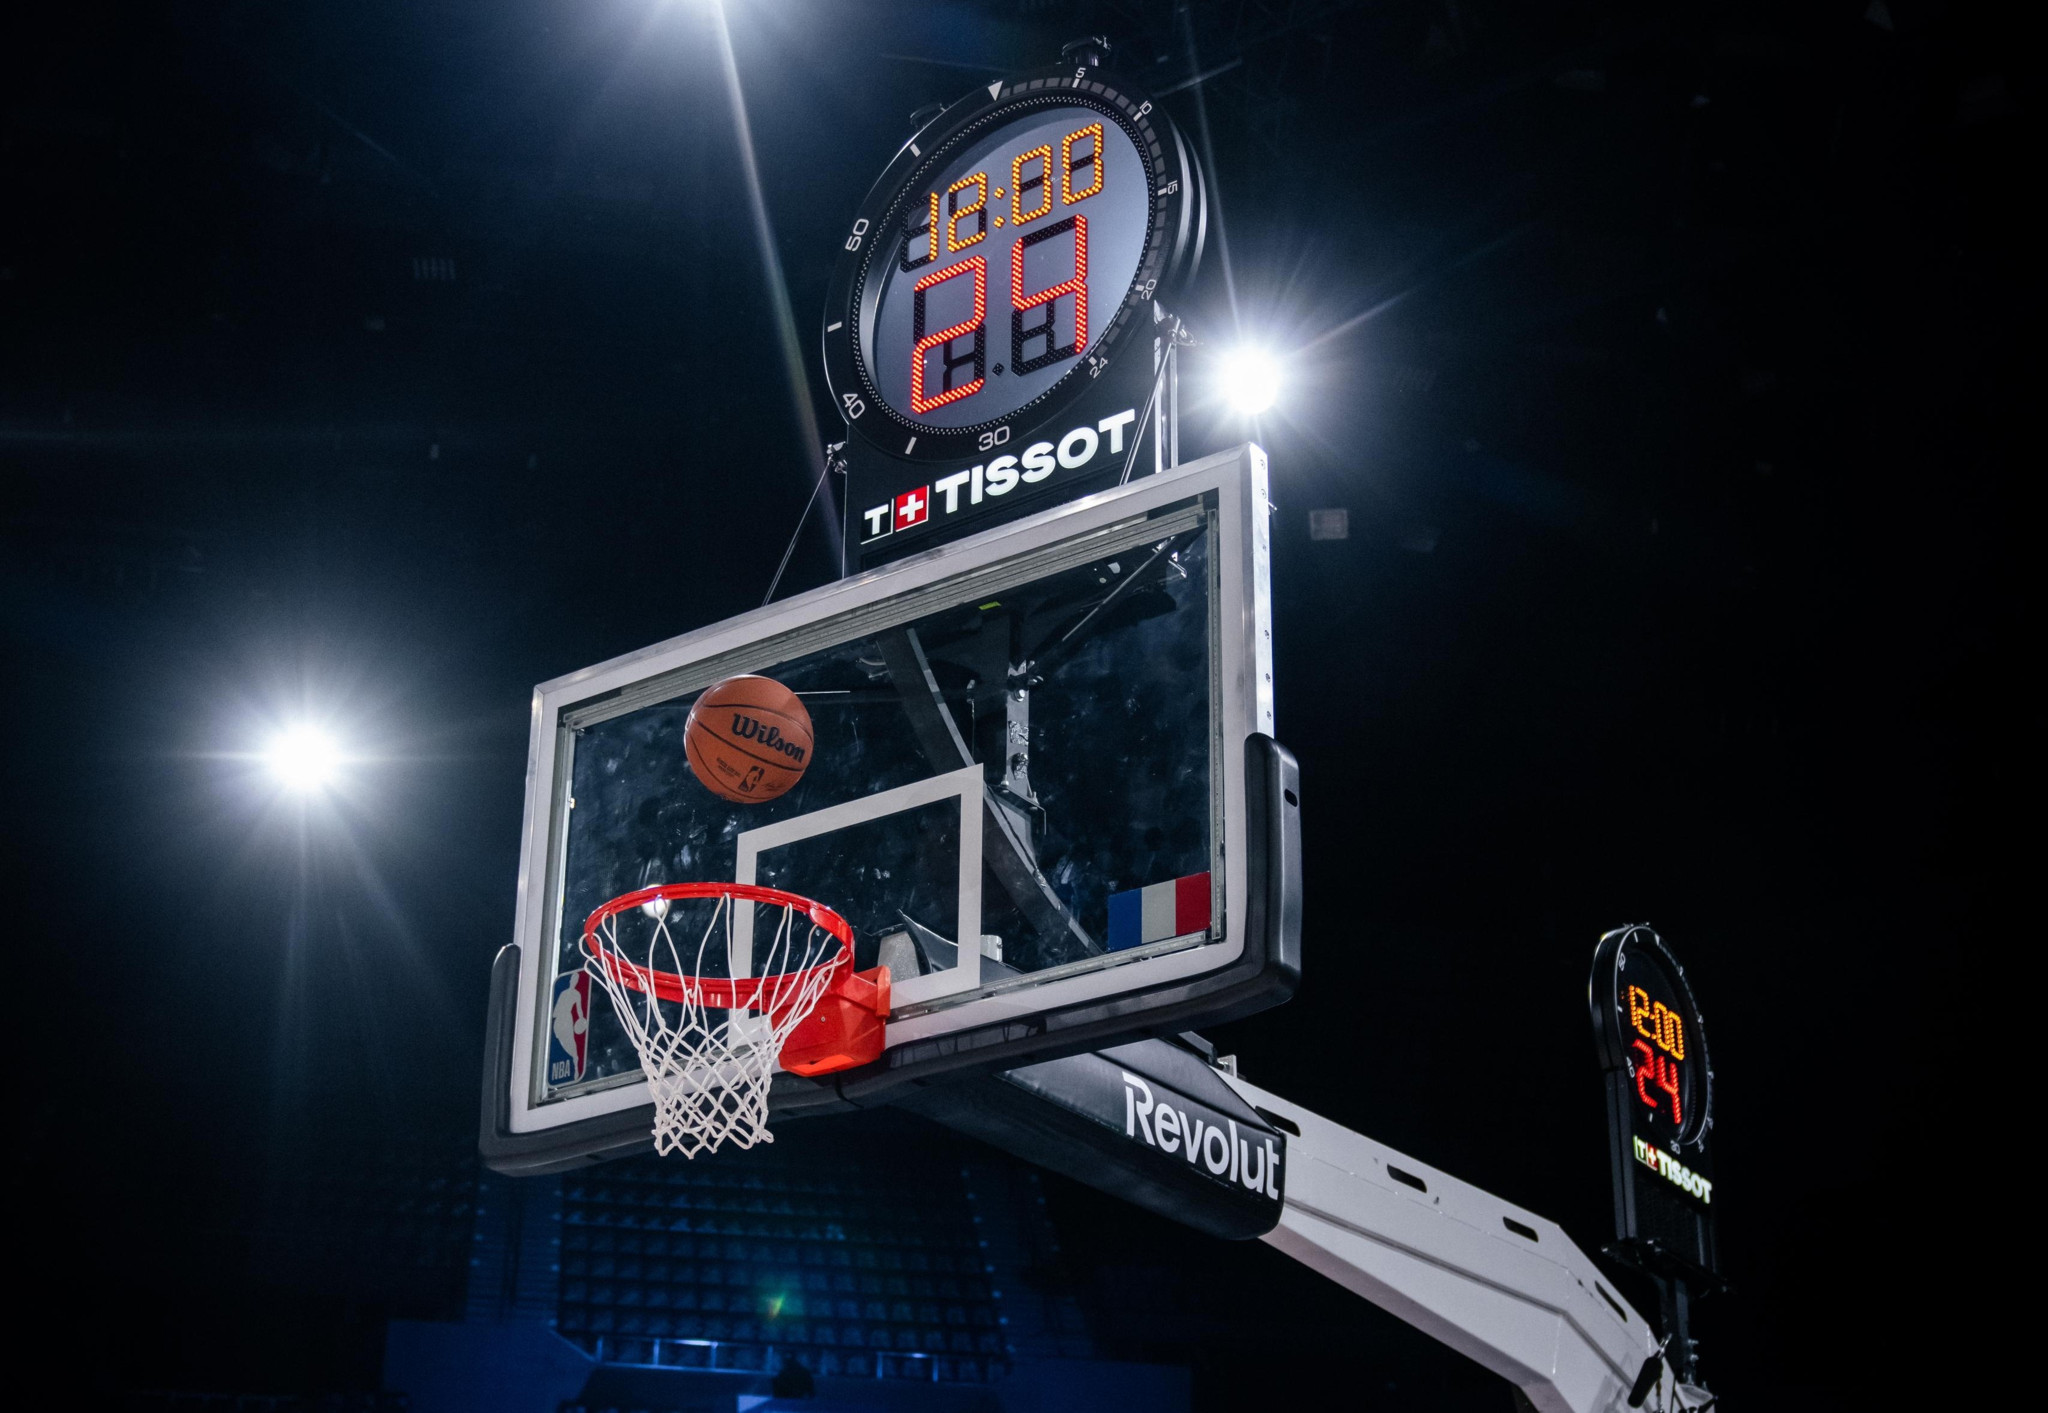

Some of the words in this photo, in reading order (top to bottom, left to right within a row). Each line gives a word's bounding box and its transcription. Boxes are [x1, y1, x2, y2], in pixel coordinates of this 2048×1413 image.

[1075, 67, 1087, 79] 5
[1138, 100, 1154, 116] 10
[929, 122, 1104, 261] 12:00
[1166, 179, 1178, 195] 15
[845, 217, 870, 252] 50
[1141, 278, 1157, 301] 20
[911, 214, 1088, 415] 24
[1089, 356, 1109, 379] 24
[842, 392, 866, 420] 40
[977, 425, 1010, 452] 30
[935, 408, 1136, 514] TISSOT
[731, 713, 806, 763] Wilson
[1629, 984, 1685, 1061] 12:00
[551, 1059, 571, 1081] NBA
[1632, 1038, 1682, 1125] 24
[1122, 1071, 1281, 1200] Revolut
[1656, 1149, 1713, 1205] TISSOT
